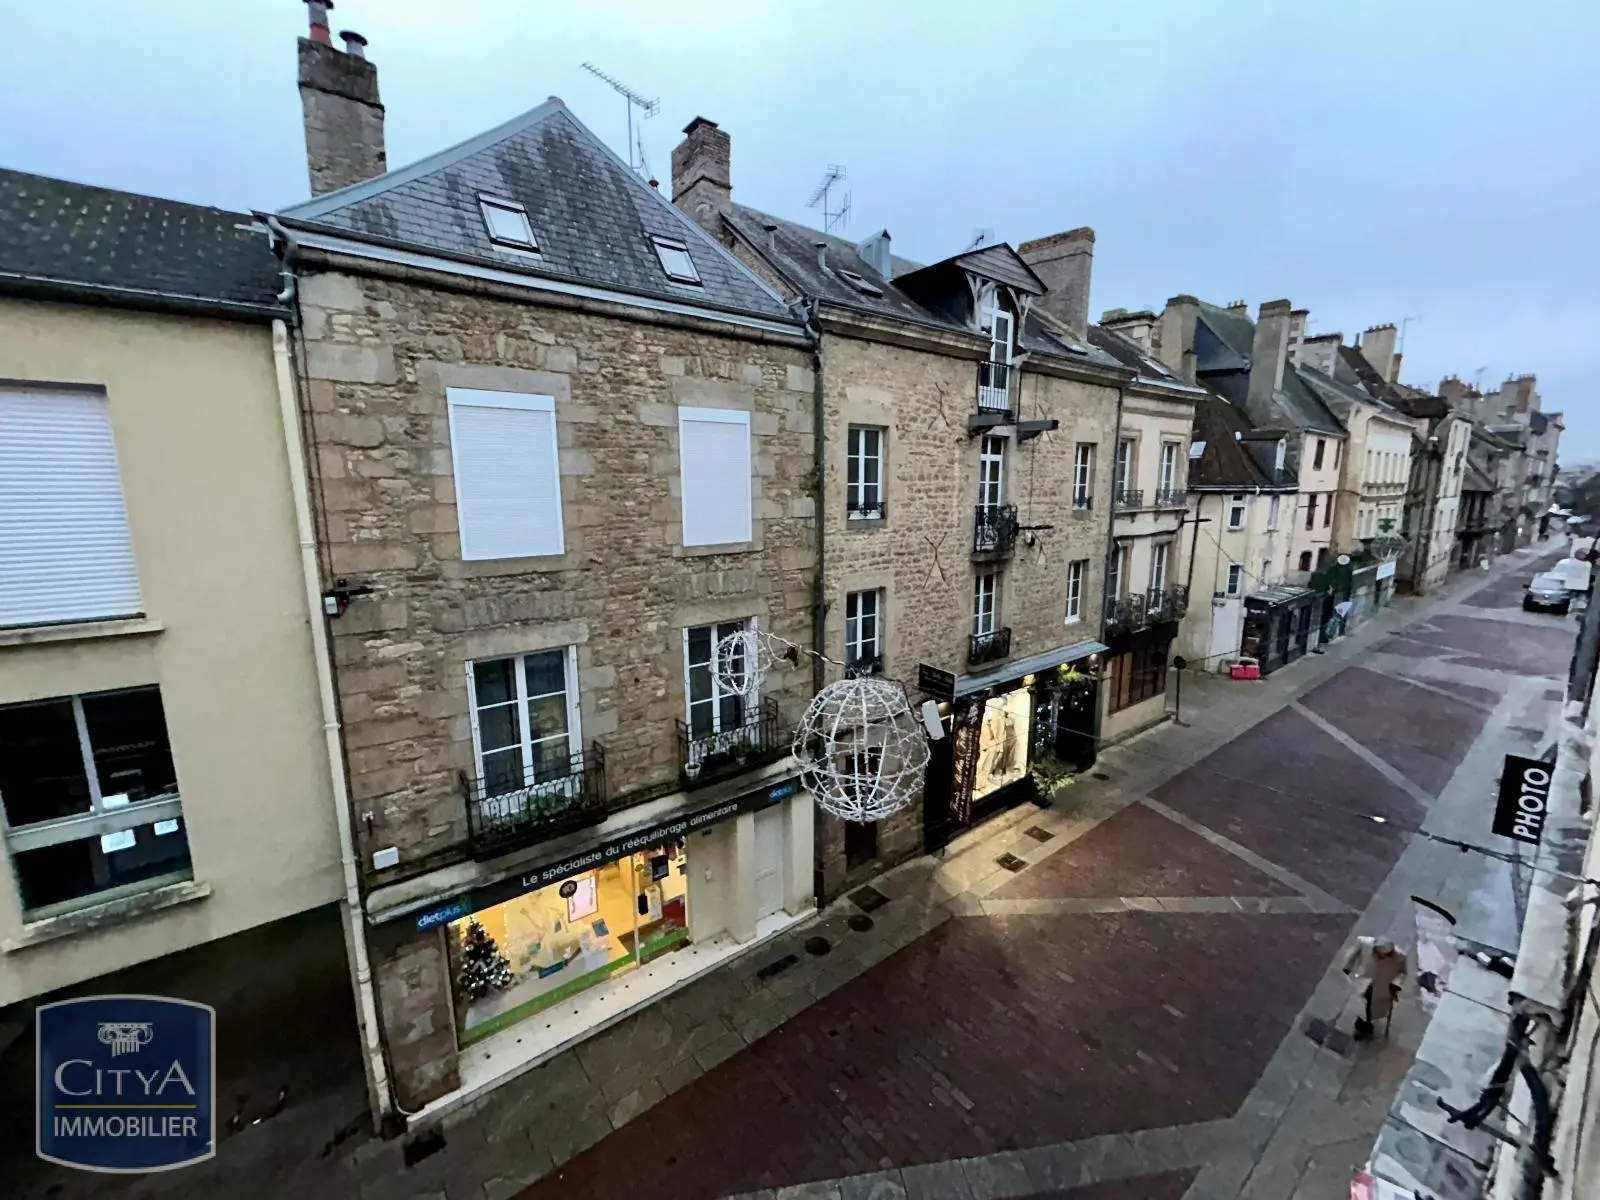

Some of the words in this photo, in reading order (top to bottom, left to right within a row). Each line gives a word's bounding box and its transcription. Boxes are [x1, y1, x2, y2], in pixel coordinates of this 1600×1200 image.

[1513, 768, 1549, 839] PHOTO
[522, 875, 538, 887] Le
[542, 852, 602, 880] spécialiste
[605, 845, 620, 857] du
[622, 821, 687, 852] rééquilibrage
[689, 803, 738, 827] alimentaire
[417, 905, 461, 927] dietplus
